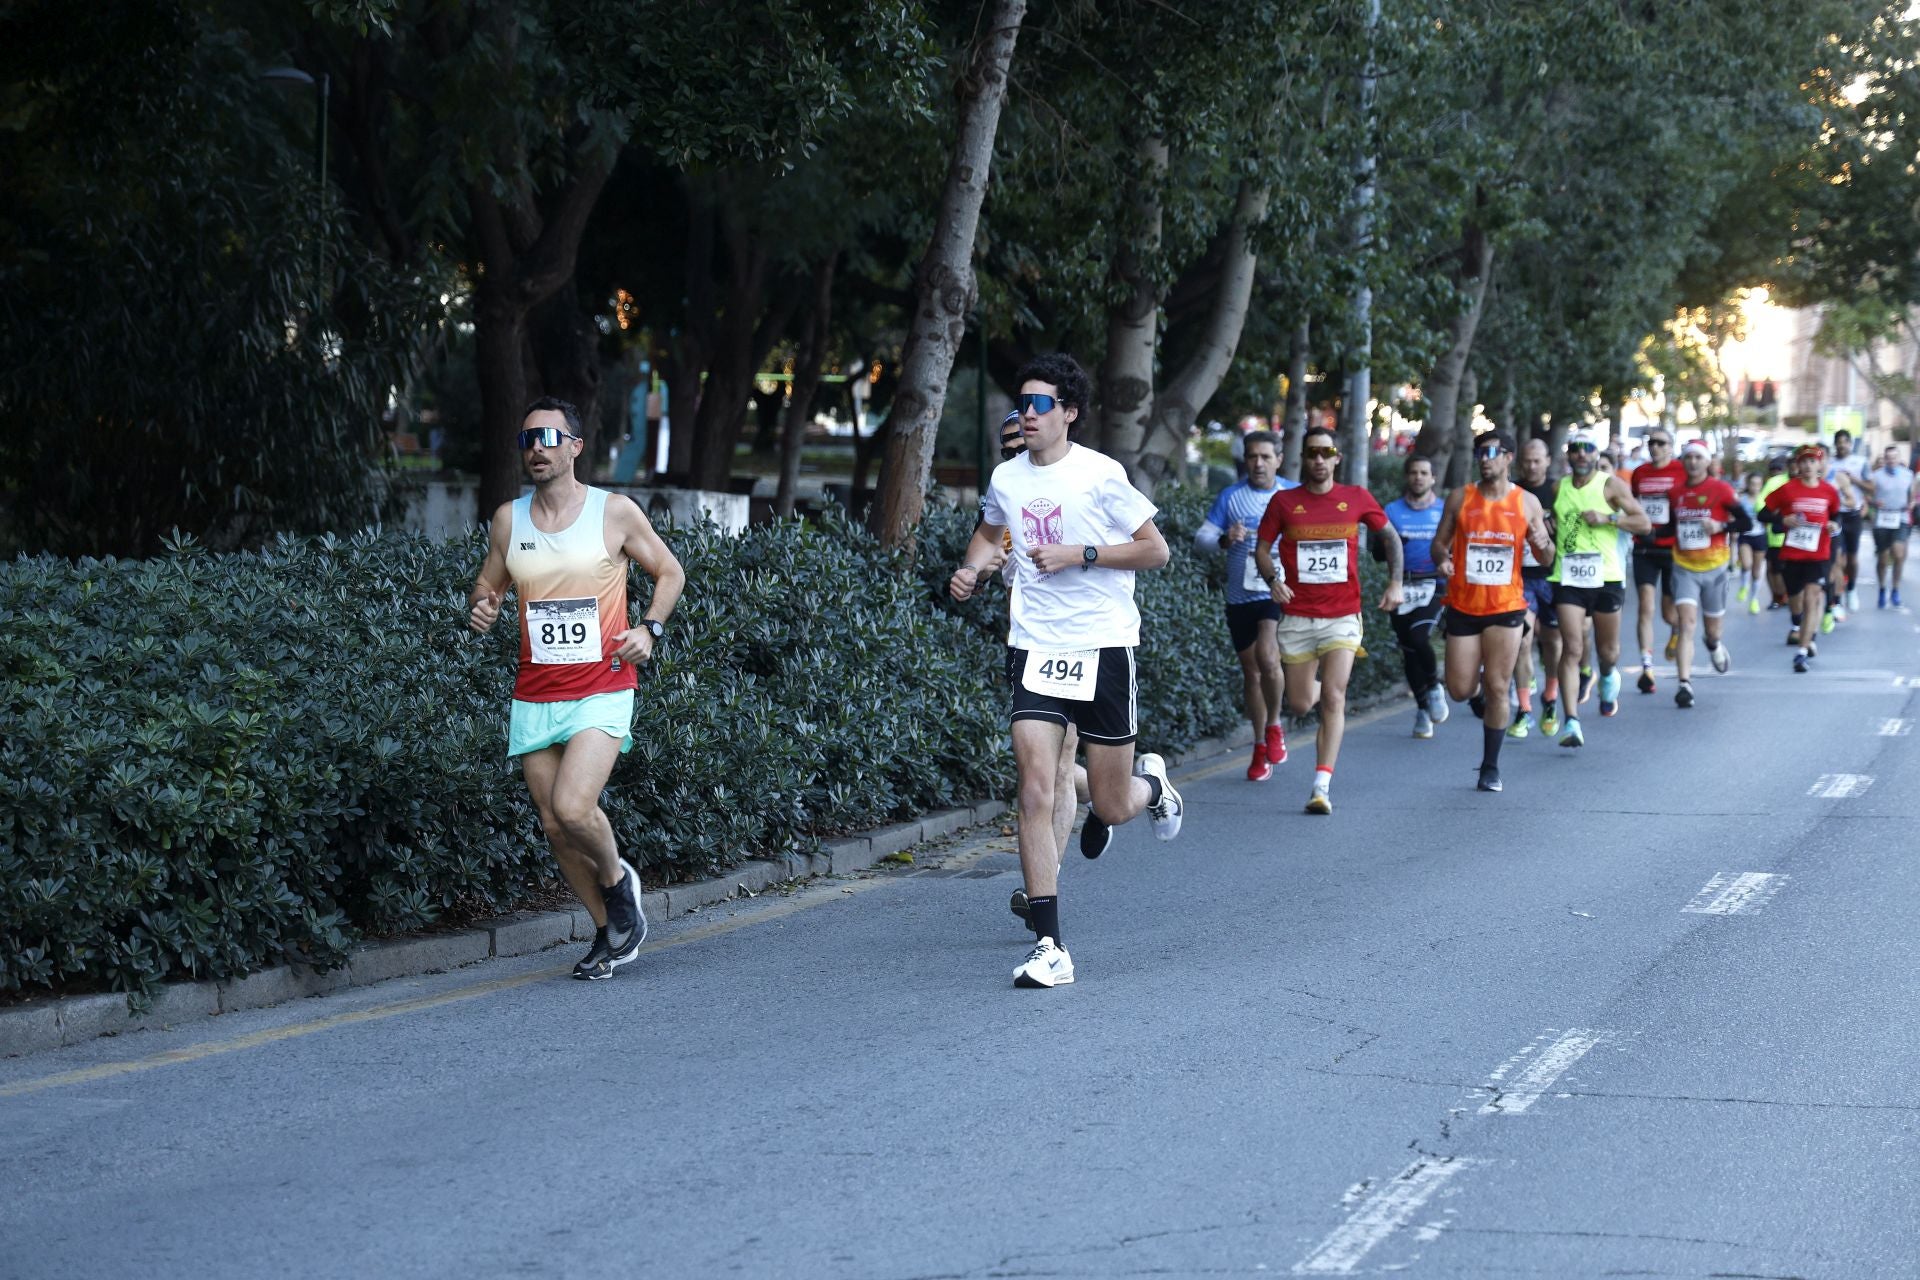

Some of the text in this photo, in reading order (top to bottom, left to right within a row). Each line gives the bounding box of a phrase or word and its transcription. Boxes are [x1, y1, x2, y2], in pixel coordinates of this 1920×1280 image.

[1308, 557, 1339, 571] 254
[1476, 560, 1504, 573] 102
[1570, 565, 1596, 577] 960
[1404, 591, 1426, 604] 334
[541, 623, 586, 645] 819
[1039, 659, 1084, 682] 494
